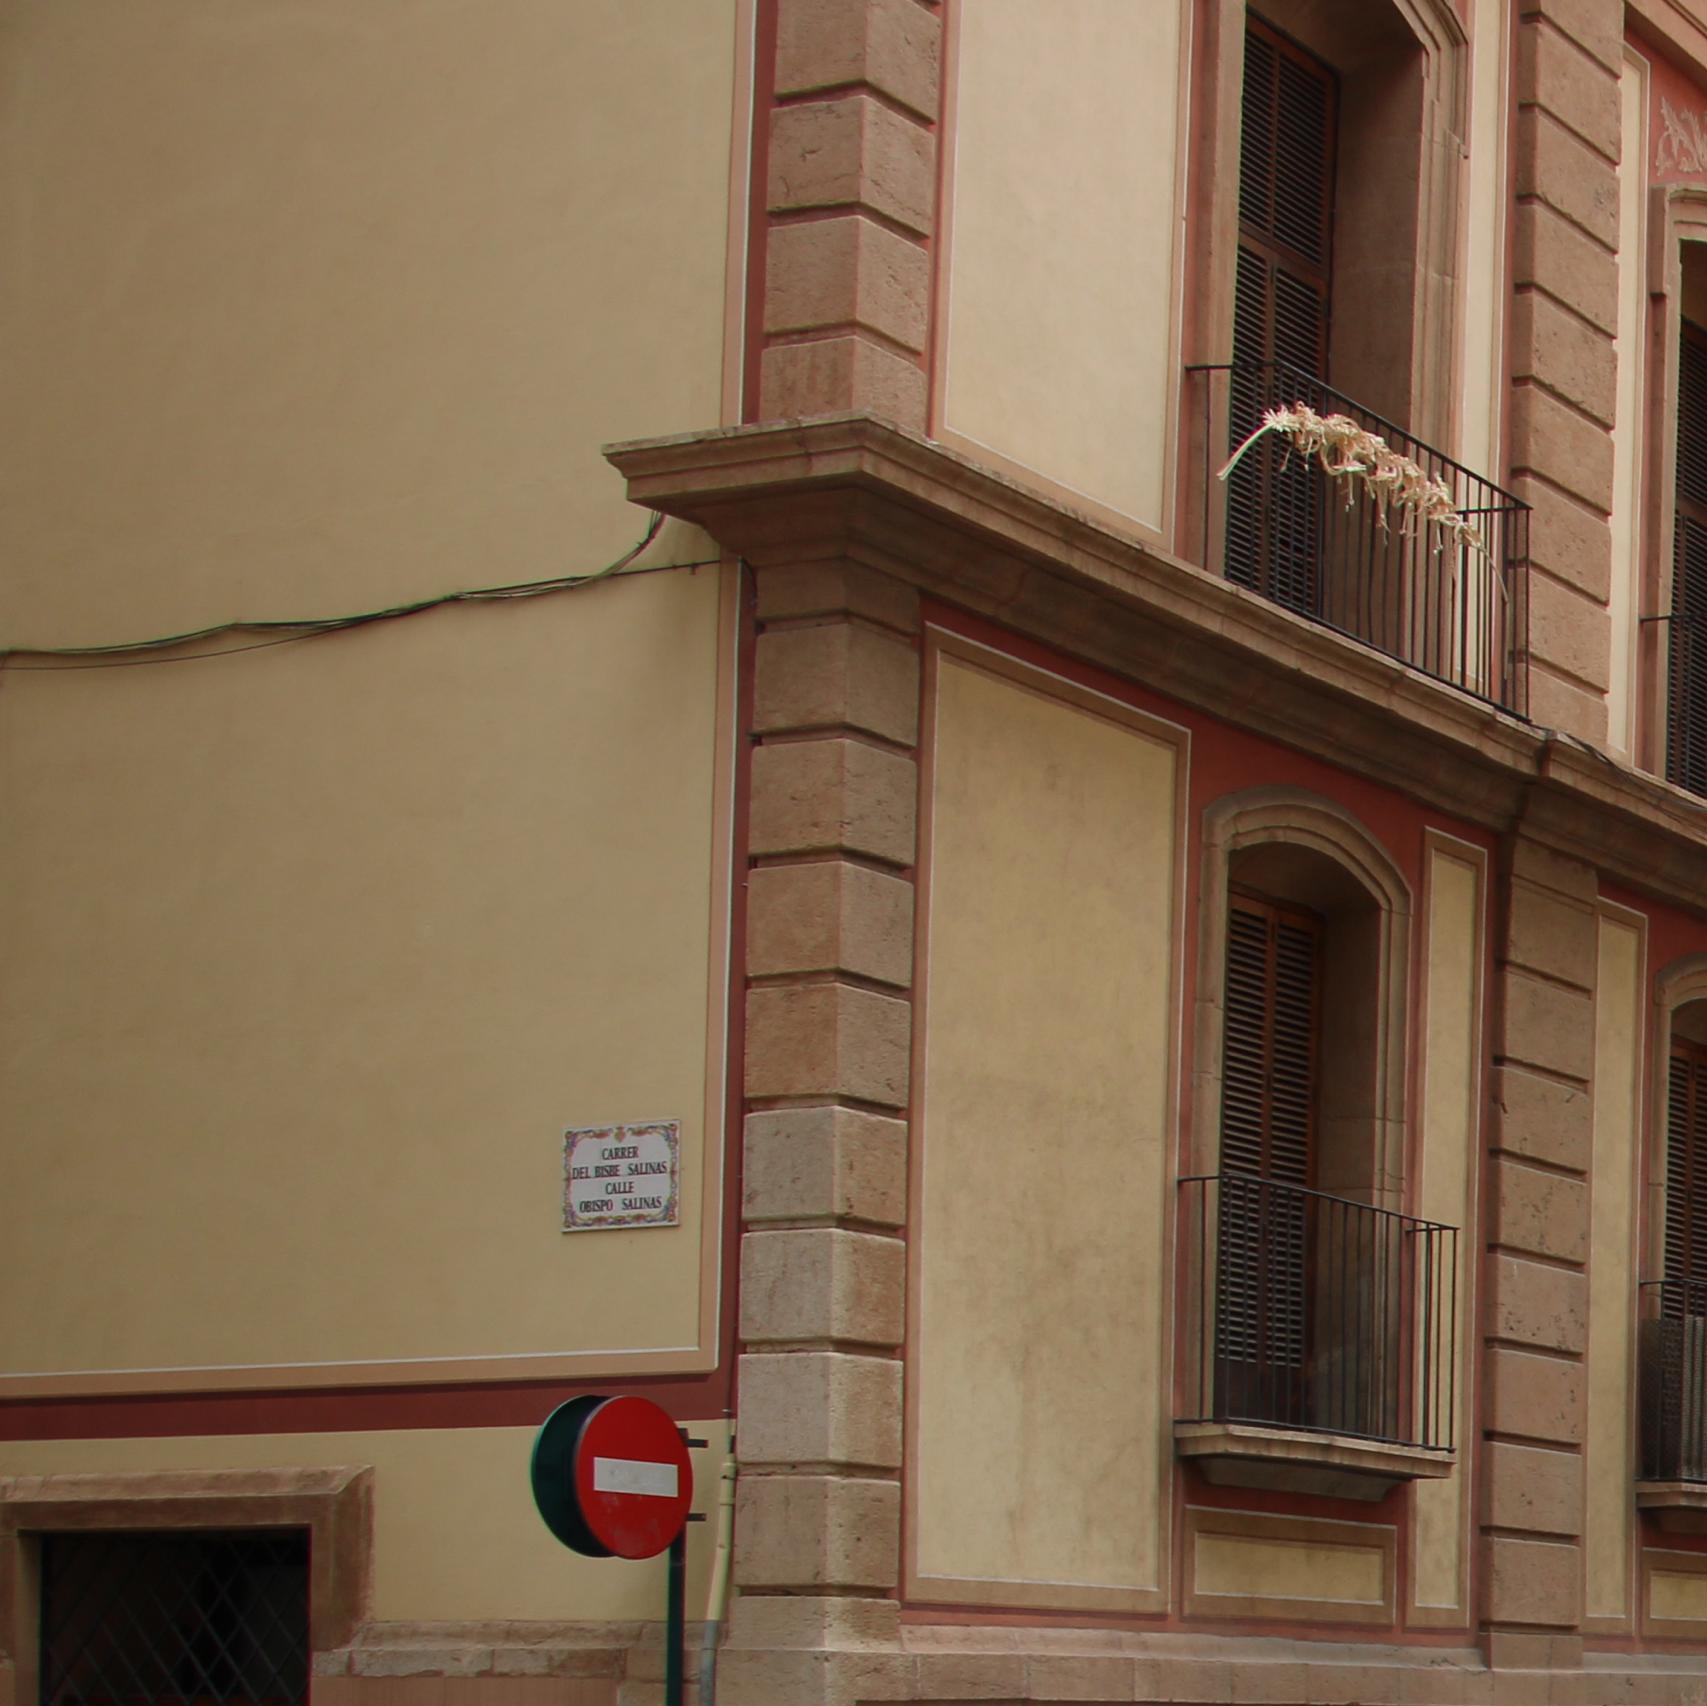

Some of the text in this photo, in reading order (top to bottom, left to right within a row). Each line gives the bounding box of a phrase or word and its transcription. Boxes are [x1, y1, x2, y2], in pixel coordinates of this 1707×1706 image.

[602, 1146, 639, 1160] CARRER
[572, 1161, 668, 1180] DEL BISBE SALINAS
[605, 1181, 635, 1195] CALLE
[579, 1196, 662, 1213] OBISPO SALINAS
